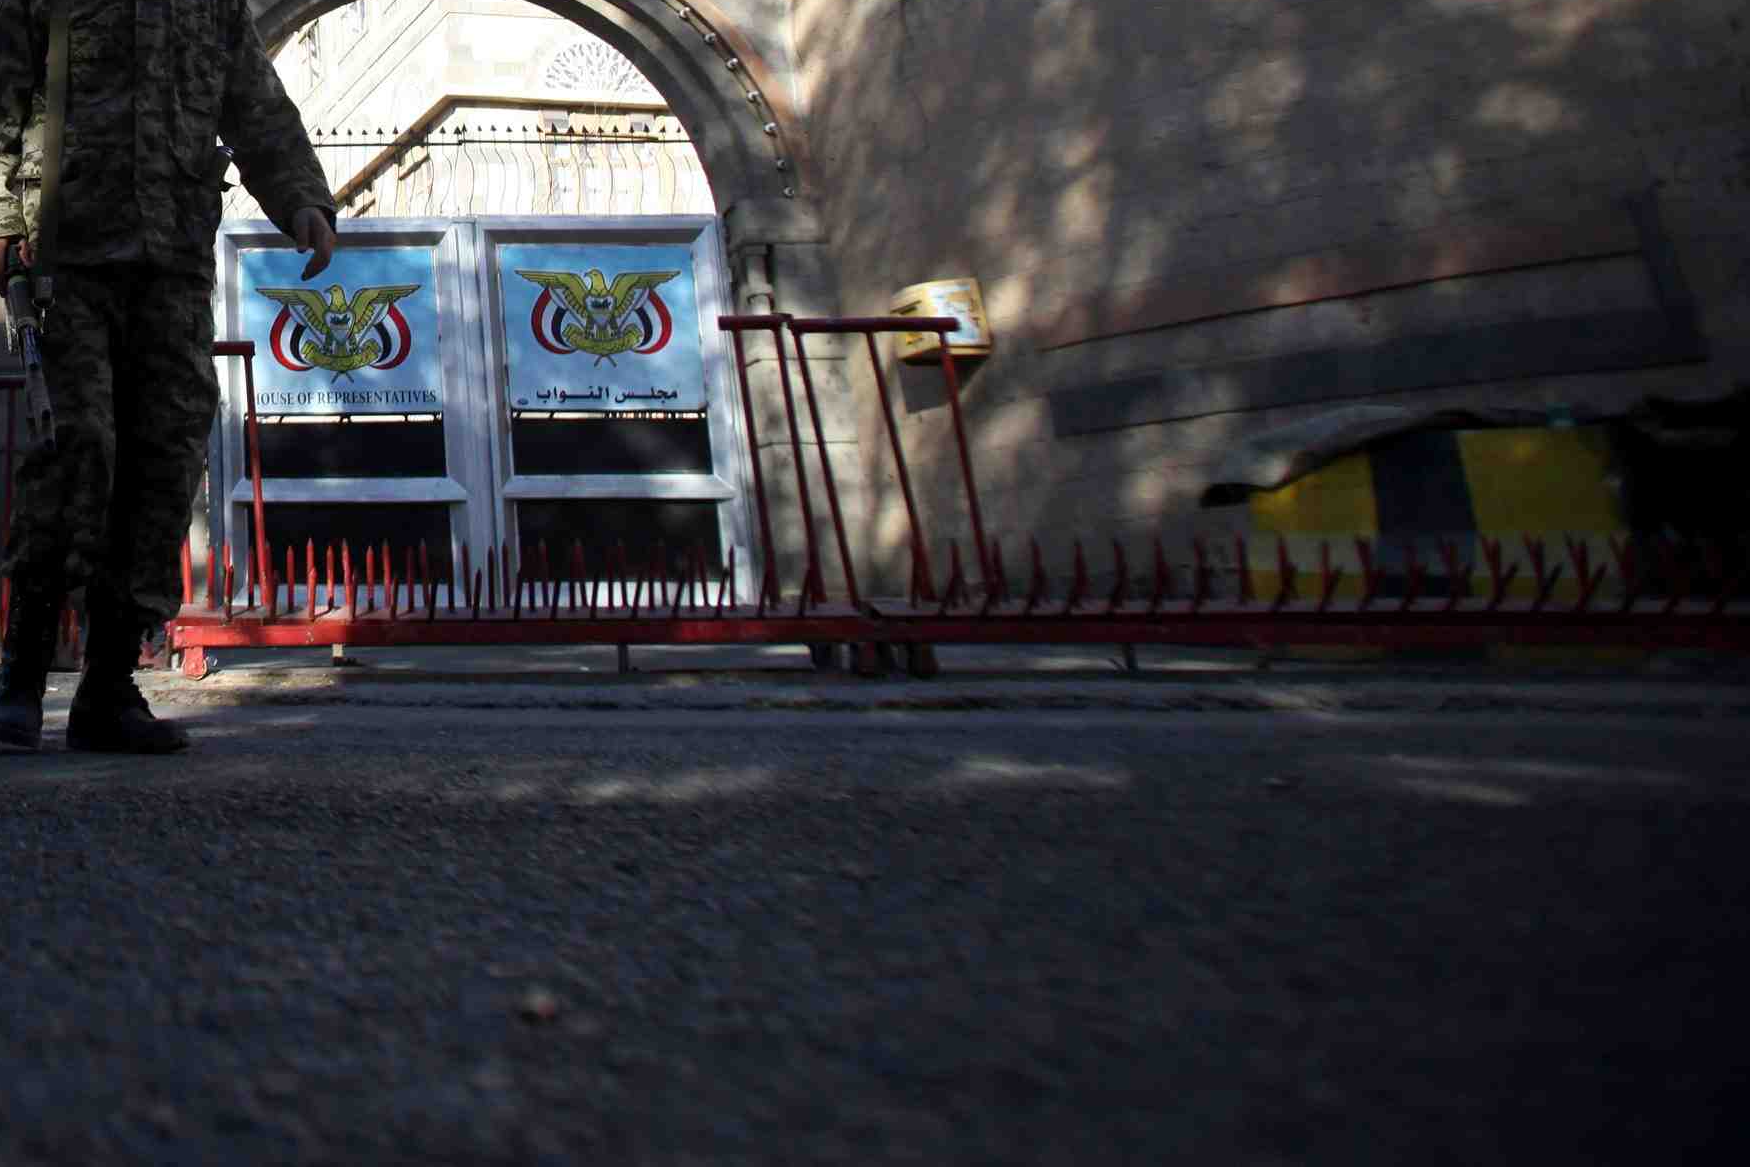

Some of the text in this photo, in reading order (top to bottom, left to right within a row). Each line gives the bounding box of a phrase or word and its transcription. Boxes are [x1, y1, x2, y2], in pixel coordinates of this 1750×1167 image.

[296, 391, 314, 406] OF
[317, 389, 438, 406] REPRESENTATIVES
[536, 384, 679, 404] مجلس النواب
